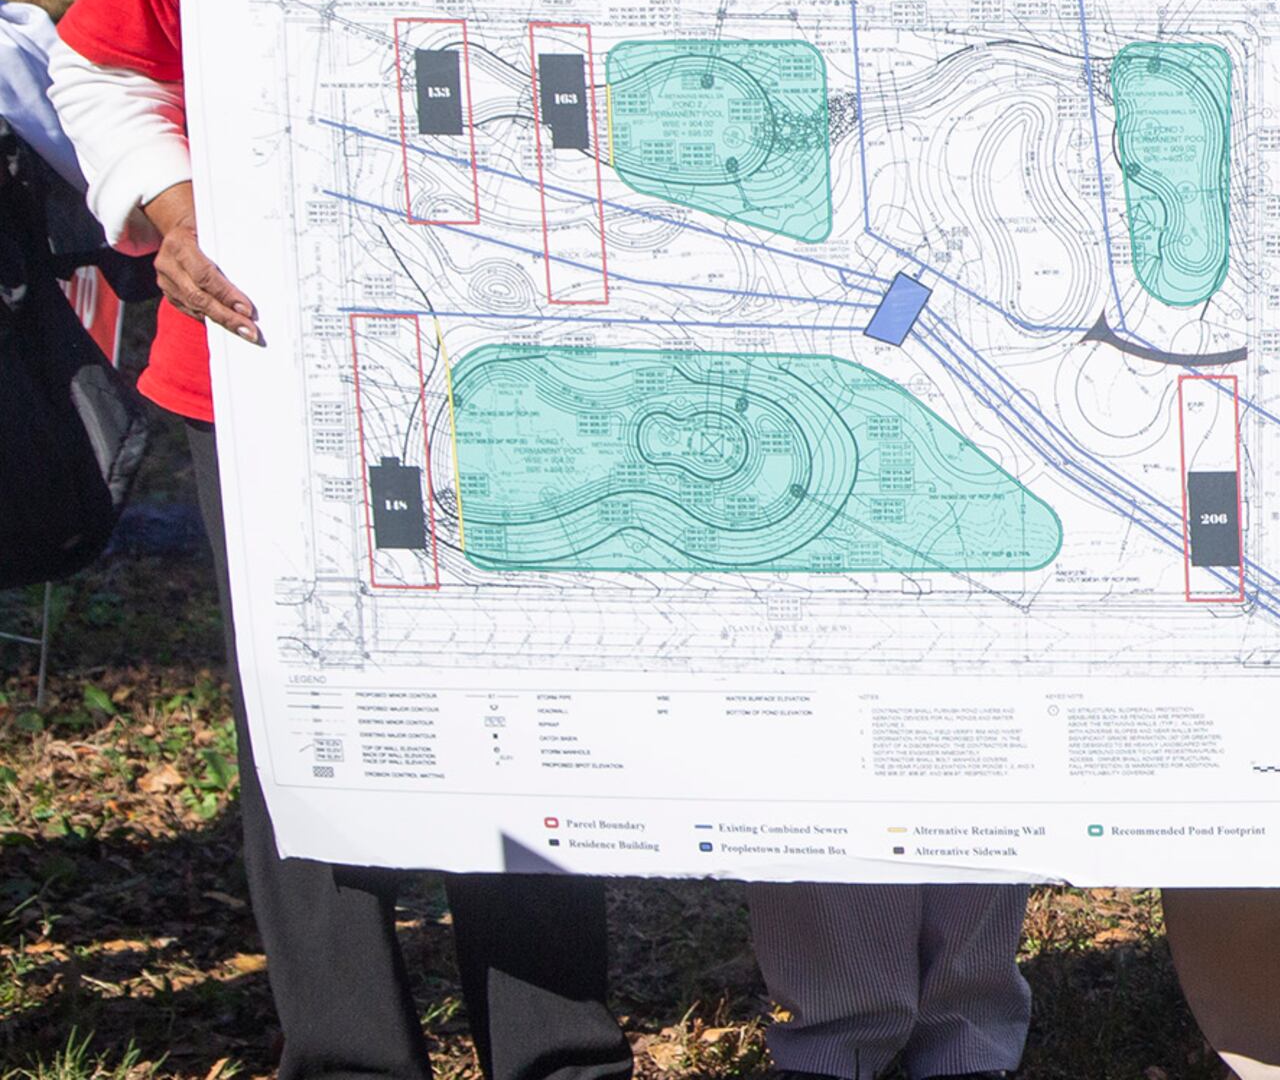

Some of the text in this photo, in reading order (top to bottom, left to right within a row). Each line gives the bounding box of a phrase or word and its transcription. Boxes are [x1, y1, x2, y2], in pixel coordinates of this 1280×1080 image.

[554, 93, 578, 104] 163
[1200, 514, 1228, 525] 206
[289, 676, 327, 684] LEGEND
[566, 820, 646, 832] Parcel Boundary
[719, 823, 848, 835] Existing Combined Sewers
[913, 825, 1046, 838] Alternative Retaining Wall
[1111, 826, 1265, 837] Recommended Pond Footprint
[569, 840, 660, 852] Residence Building
[721, 844, 847, 856] Peoplestown Junction Box
[915, 846, 1018, 857] Alternative Sidewalk
